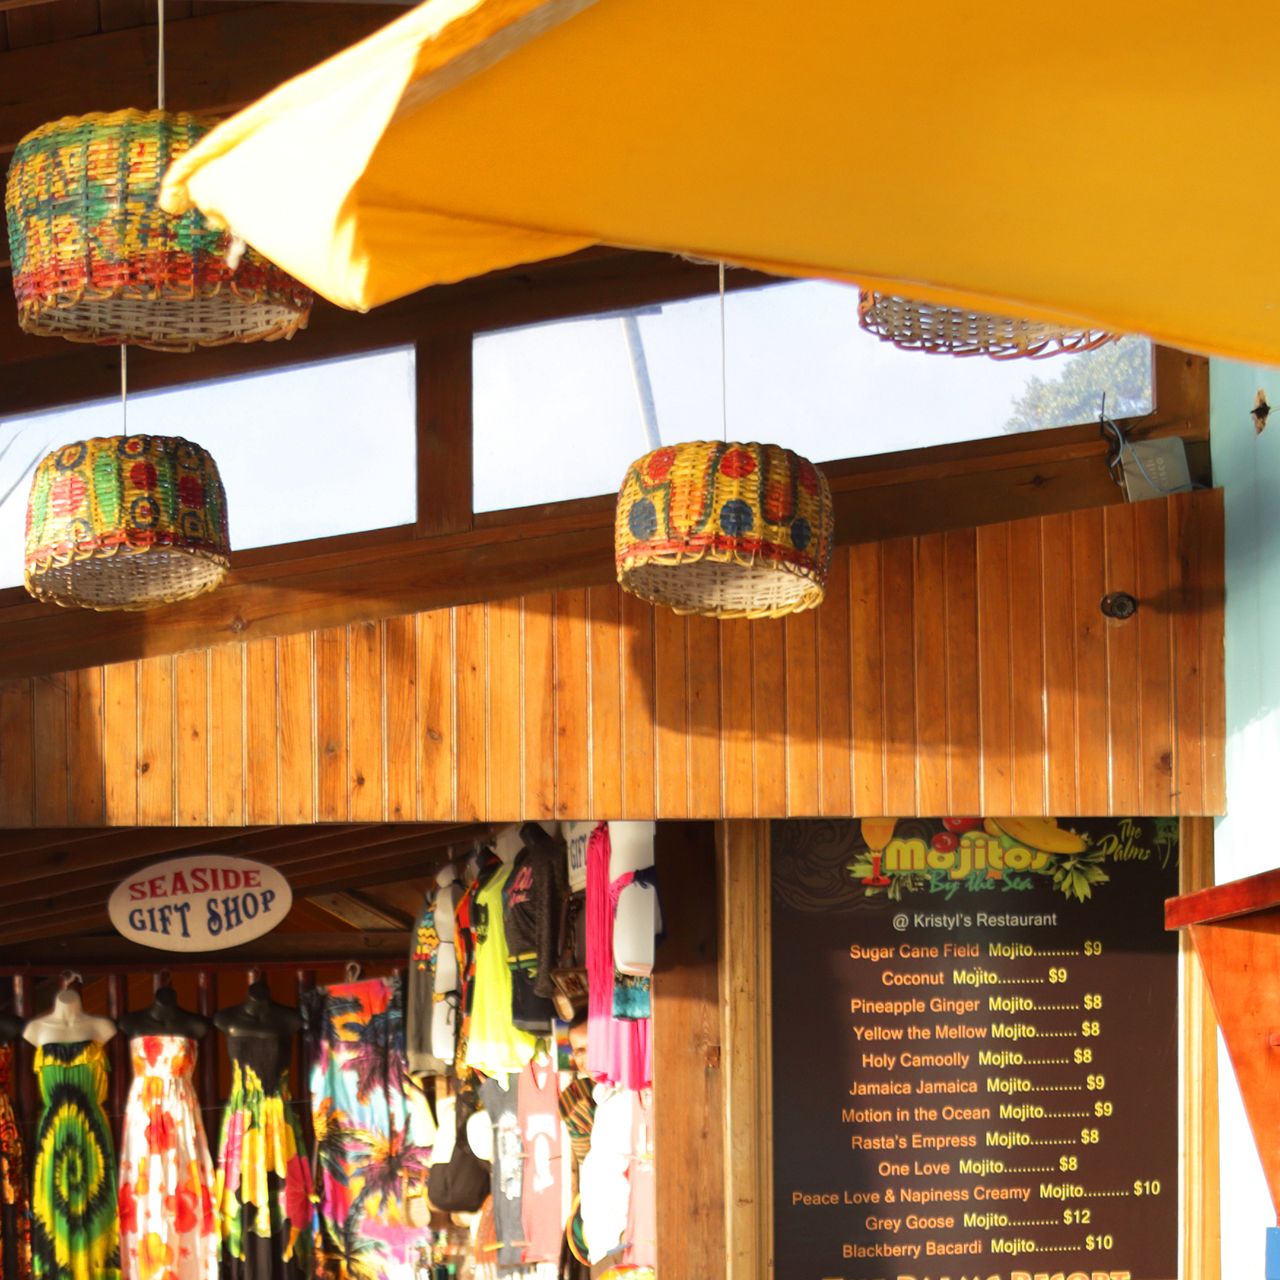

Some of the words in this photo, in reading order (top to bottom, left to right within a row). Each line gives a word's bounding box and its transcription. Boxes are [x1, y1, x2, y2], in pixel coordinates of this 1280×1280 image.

[1096, 834, 1151, 862] Palms
[128, 868, 261, 900] SEASIDE
[929, 869, 961, 901] By
[966, 869, 996, 891] the
[1001, 869, 1033, 892] Sea
[128, 902, 191, 937] GIFT
[207, 890, 276, 936] SHOP
[892, 914, 909, 931] @
[913, 912, 972, 931] Kristyl's
[976, 912, 1057, 928] Restaurant
[850, 944, 895, 962] Sugar
[899, 943, 939, 958] Cane
[943, 942, 979, 957] Field
[1083, 940, 1102, 957] $9
[881, 970, 944, 986] Coconut
[1048, 966, 1067, 984] $9
[850, 998, 926, 1016] Pineapple
[930, 997, 980, 1015] Ginger
[1083, 992, 1102, 1010] $8
[852, 1026, 904, 1041] Yellow
[907, 1025, 931, 1040] the
[935, 1023, 987, 1039] Mellow
[1081, 1020, 1100, 1037] $8
[862, 1053, 896, 1071] Holy
[900, 1051, 970, 1069] Camoolly
[1073, 1047, 1092, 1064] $8
[849, 1080, 911, 1096] Jamaica
[915, 1079, 978, 1094] Jamaica
[1086, 1074, 1105, 1091] $9
[842, 1108, 892, 1123] Motion
[896, 1107, 910, 1122] in
[914, 1106, 938, 1121] the
[942, 1105, 990, 1120] Ocean
[1094, 1101, 1113, 1118] $9
[851, 1134, 907, 1150] Rasta's
[911, 1132, 977, 1151] Empress
[1081, 1127, 1100, 1145] $8
[878, 1161, 910, 1177] One
[914, 1160, 951, 1176] Love
[1059, 1155, 1078, 1172] $8
[792, 1191, 840, 1206] Peace
[844, 1190, 881, 1205] Love
[884, 1188, 896, 1204] &
[900, 1187, 970, 1205] Napiness
[973, 1185, 1031, 1202] Creamy
[1133, 1179, 1161, 1196] $10
[865, 1215, 902, 1234] Grey
[905, 1214, 955, 1230] Goose
[1063, 1208, 1091, 1225] $12
[842, 1243, 921, 1259] Blackberry
[925, 1240, 982, 1256] Bacardi
[1085, 1234, 1113, 1251] $10
